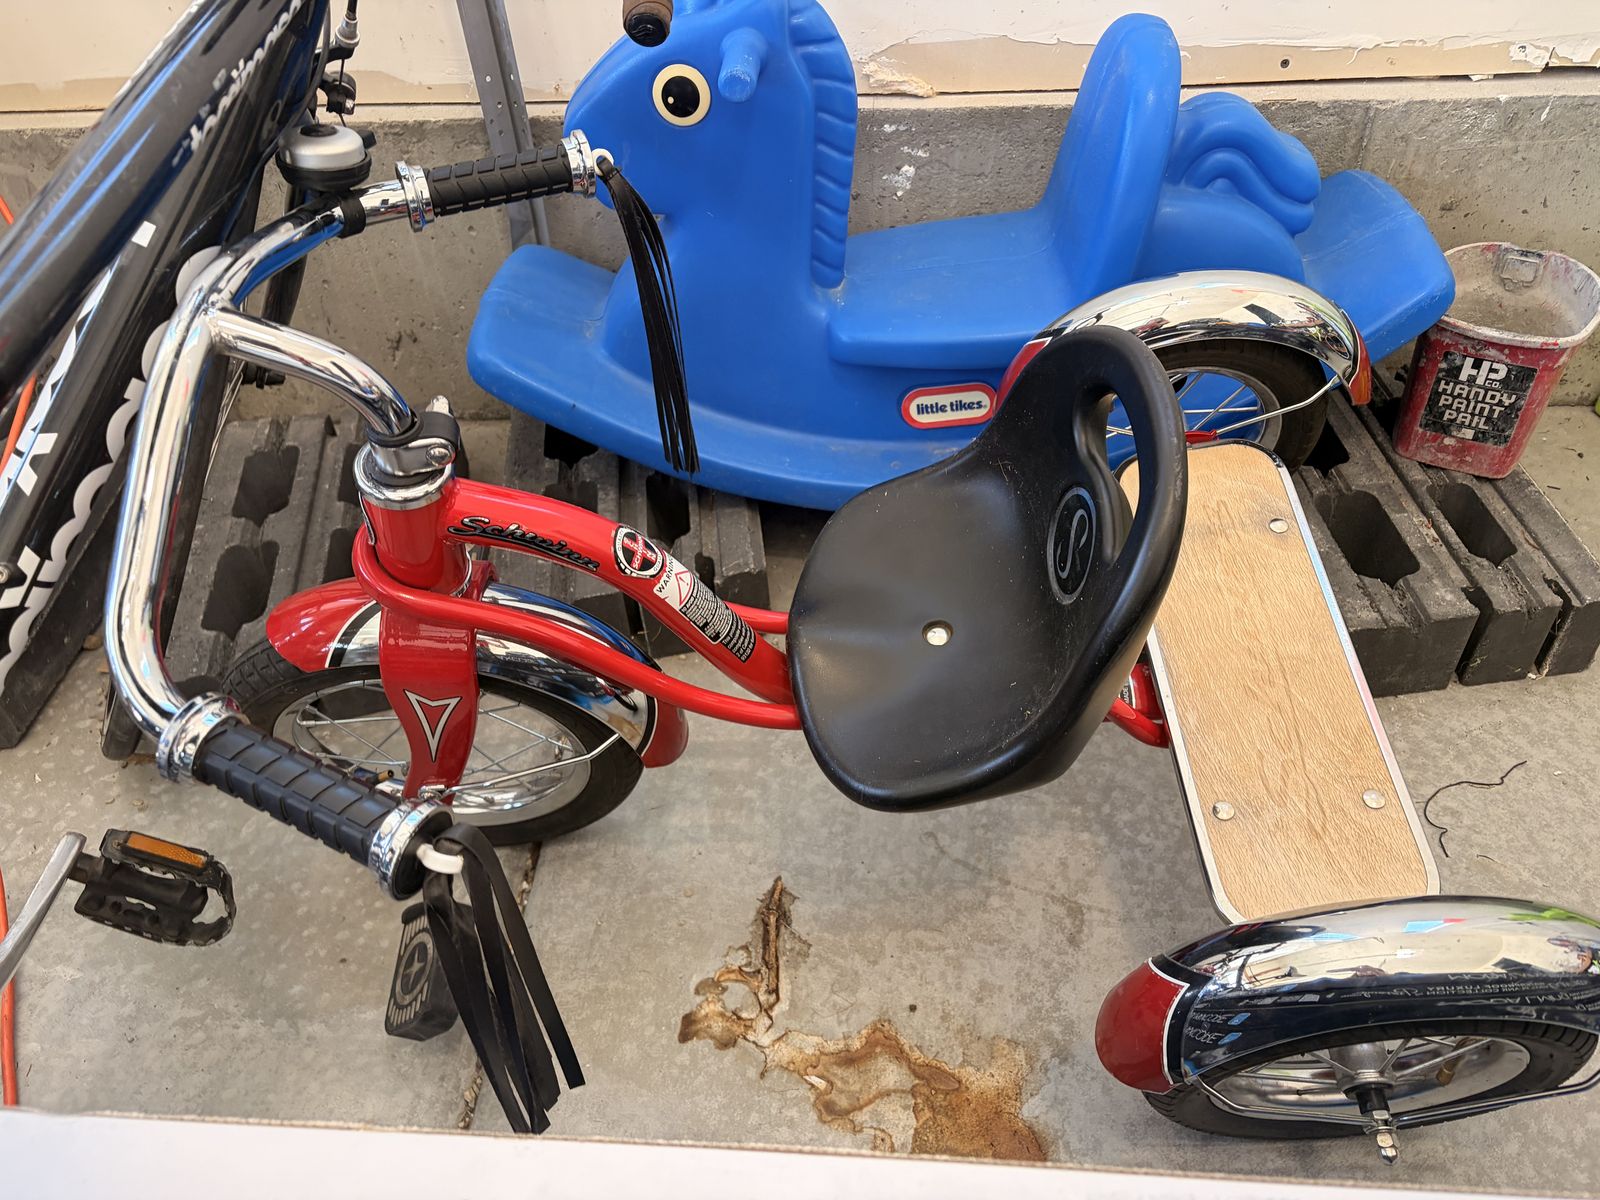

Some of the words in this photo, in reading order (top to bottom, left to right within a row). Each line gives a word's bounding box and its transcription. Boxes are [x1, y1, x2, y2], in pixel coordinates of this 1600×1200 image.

[1438, 380, 1517, 406] HANDY
[916, 402, 947, 415] little
[1438, 394, 1505, 418] PAINT
[1442, 409, 1489, 430] PAIL
[448, 516, 600, 572] Schwinn
